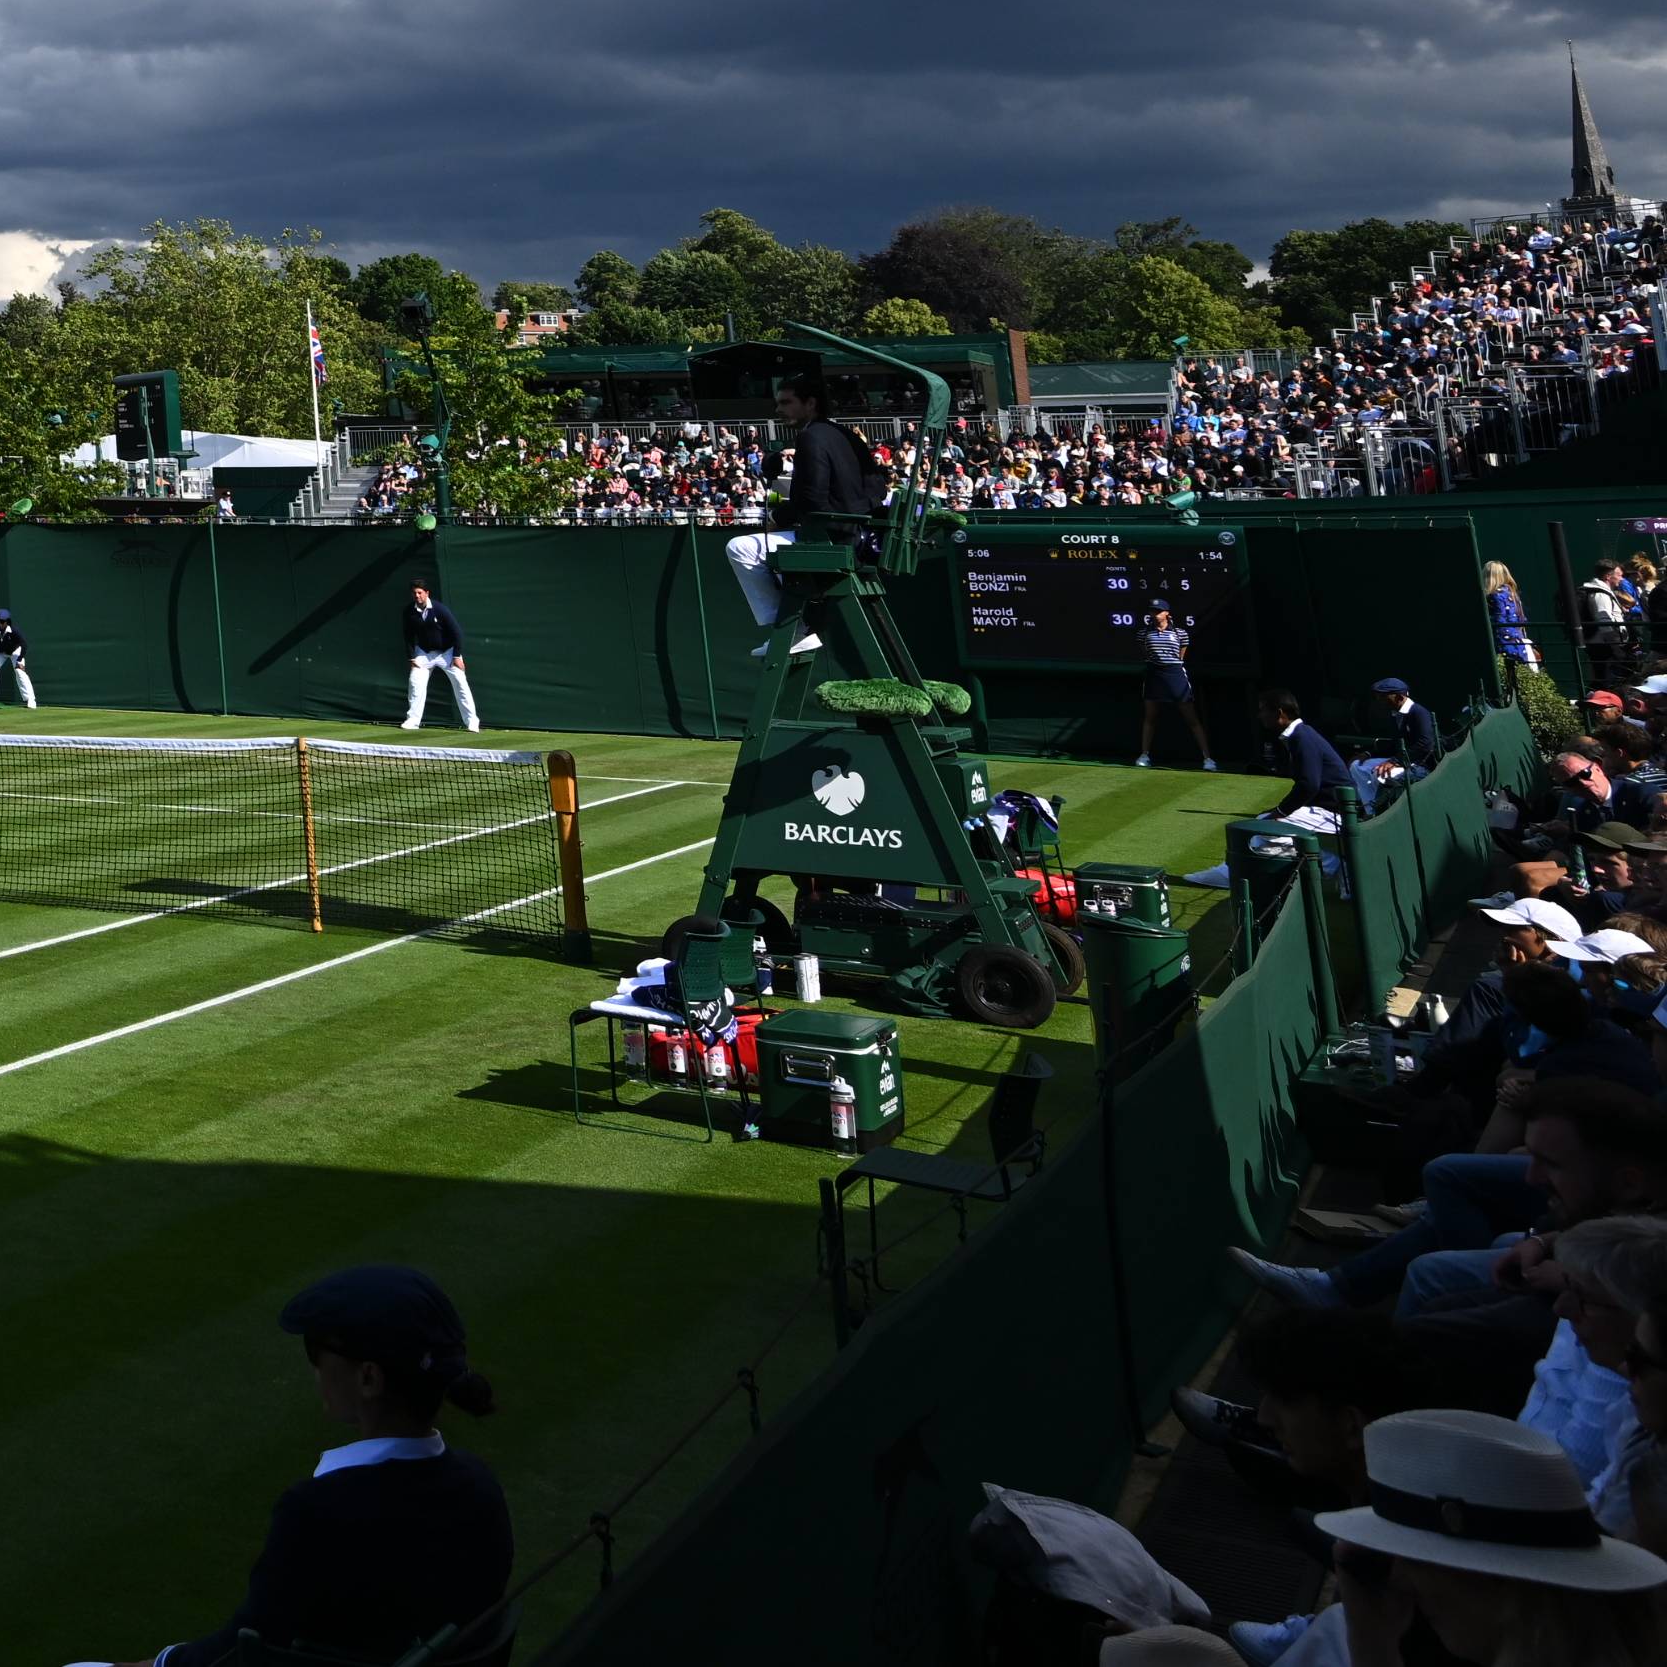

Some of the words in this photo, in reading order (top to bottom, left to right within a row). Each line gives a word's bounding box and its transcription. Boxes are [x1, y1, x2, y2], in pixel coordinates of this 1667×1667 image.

[1061, 534, 1107, 544] COURT
[1111, 535, 1120, 544] 8
[967, 549, 990, 558] 5:06
[1067, 549, 1119, 559] ROLEX
[1198, 551, 1223, 560] 1:54
[967, 571, 1027, 583] Benjamin
[969, 582, 1010, 592] BONZI
[1107, 578, 1129, 590] 30
[1139, 579, 1147, 590] 3
[1159, 579, 1169, 590] 4
[1180, 579, 1190, 591] 5
[972, 606, 1014, 616] Harold
[973, 616, 1019, 627] MAYOT
[1112, 613, 1133, 625] 30
[1186, 615, 1195, 627] 5
[971, 784, 987, 805] evian
[784, 821, 903, 849] BARCLAYS
[879, 1073, 896, 1096] evian
